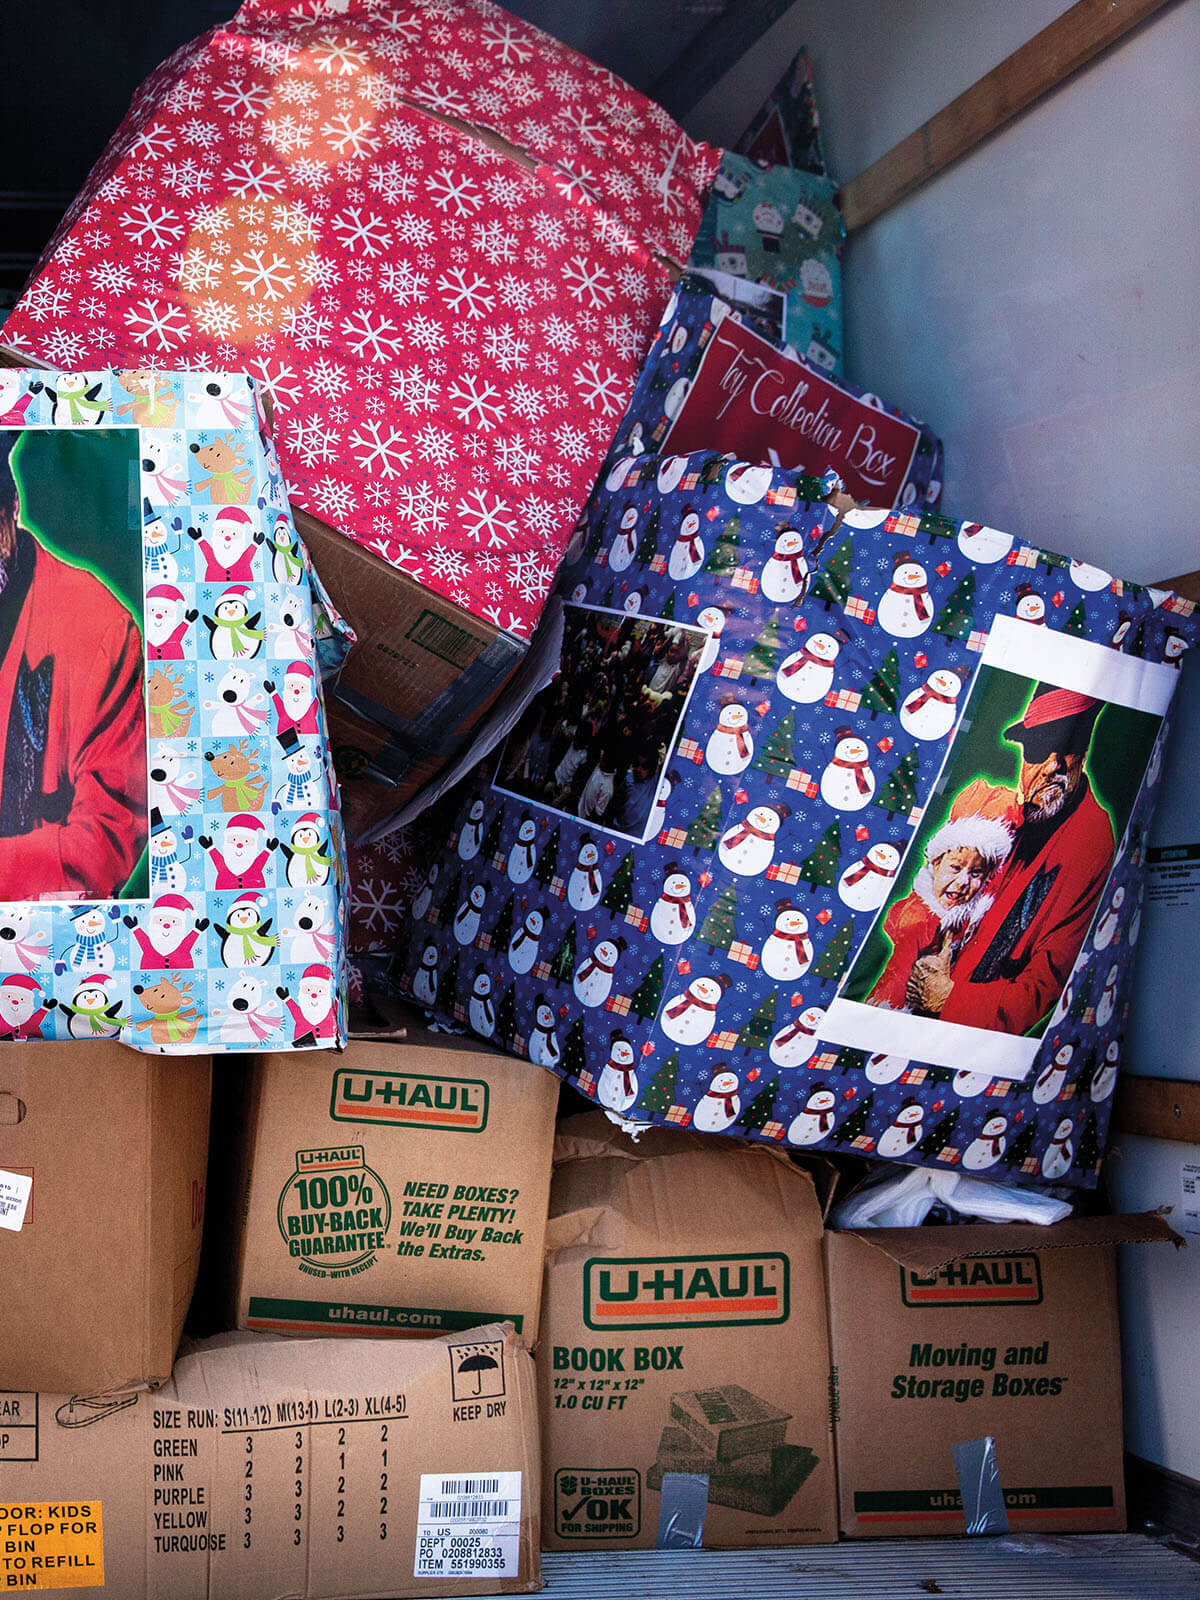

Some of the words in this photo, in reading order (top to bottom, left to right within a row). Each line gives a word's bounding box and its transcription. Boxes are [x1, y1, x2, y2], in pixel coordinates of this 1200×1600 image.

[717, 336, 766, 420] Toy
[751, 370, 843, 451] Collection
[845, 424, 896, 483] Box
[294, 1173, 373, 1210] 100%
[403, 1181, 449, 1199] NEED
[453, 1185, 519, 1204] BOXES?
[287, 1208, 383, 1237] BUY-BACK
[403, 1201, 444, 1220] TAKE
[447, 1205, 516, 1224] PLENTY!
[400, 1221, 440, 1239] We'll
[444, 1225, 477, 1244] Buy
[481, 1226, 524, 1244] Back
[397, 1241, 424, 1257] the
[429, 1244, 486, 1261] Extras.
[328, 1305, 442, 1326] uhaul.com
[553, 1347, 625, 1371] BOOK
[633, 1346, 684, 1369] BOX
[909, 1342, 997, 1371] Moving
[1004, 1341, 1049, 1365] and
[891, 1375, 984, 1402] Storage
[153, 1411, 181, 1429] SIZE
[187, 1409, 218, 1428] RUN:
[224, 1404, 271, 1427] S(11-12)
[277, 1400, 319, 1422] M(13-1)
[325, 1398, 359, 1418] L(2-3)
[365, 1394, 406, 1415] XL(4-5)
[453, 1405, 481, 1422] KEEP
[487, 1401, 507, 1418] DRY
[153, 1438, 198, 1457] GREEN
[245, 1436, 253, 1454] 3
[295, 1431, 303, 1449] 3
[338, 1428, 346, 1446] 2
[381, 1424, 388, 1442] 2
[154, 1463, 184, 1482] PINK
[245, 1460, 253, 1478] 2
[295, 1456, 303, 1474] 2
[339, 1452, 345, 1470] 1
[382, 1449, 388, 1467] 1
[154, 1487, 205, 1506] PURPLE
[245, 1483, 252, 1501] 3
[295, 1479, 302, 1497] 3
[338, 1475, 345, 1494] 2
[380, 1473, 388, 1491] 2
[48, 1505, 92, 1519] KIDS
[154, 1511, 208, 1529] YELLOW
[244, 1507, 252, 1524] 3
[294, 1503, 302, 1521] 3
[337, 1500, 345, 1517] 2
[380, 1497, 388, 1514] 2
[7, 1523, 55, 1537] FLOP
[60, 1522, 97, 1535] FOR
[154, 1534, 226, 1553] TURQUOISE
[244, 1532, 251, 1549] 3
[294, 1528, 301, 1546] 3
[337, 1525, 344, 1543] 3
[380, 1522, 387, 1540] 3
[437, 1528, 451, 1536] US
[5, 1540, 36, 1553] BIN
[419, 1549, 433, 1558] PO
[442, 1548, 502, 1558] 0208812833
[420, 1538, 445, 1548] DEPT
[450, 1537, 481, 1547] 00025
[3, 1557, 26, 1570] TO
[31, 1555, 95, 1569] REFILL
[419, 1559, 443, 1569] ITEM
[451, 1558, 506, 1569] 551990355
[6, 1573, 37, 1586] BIN
